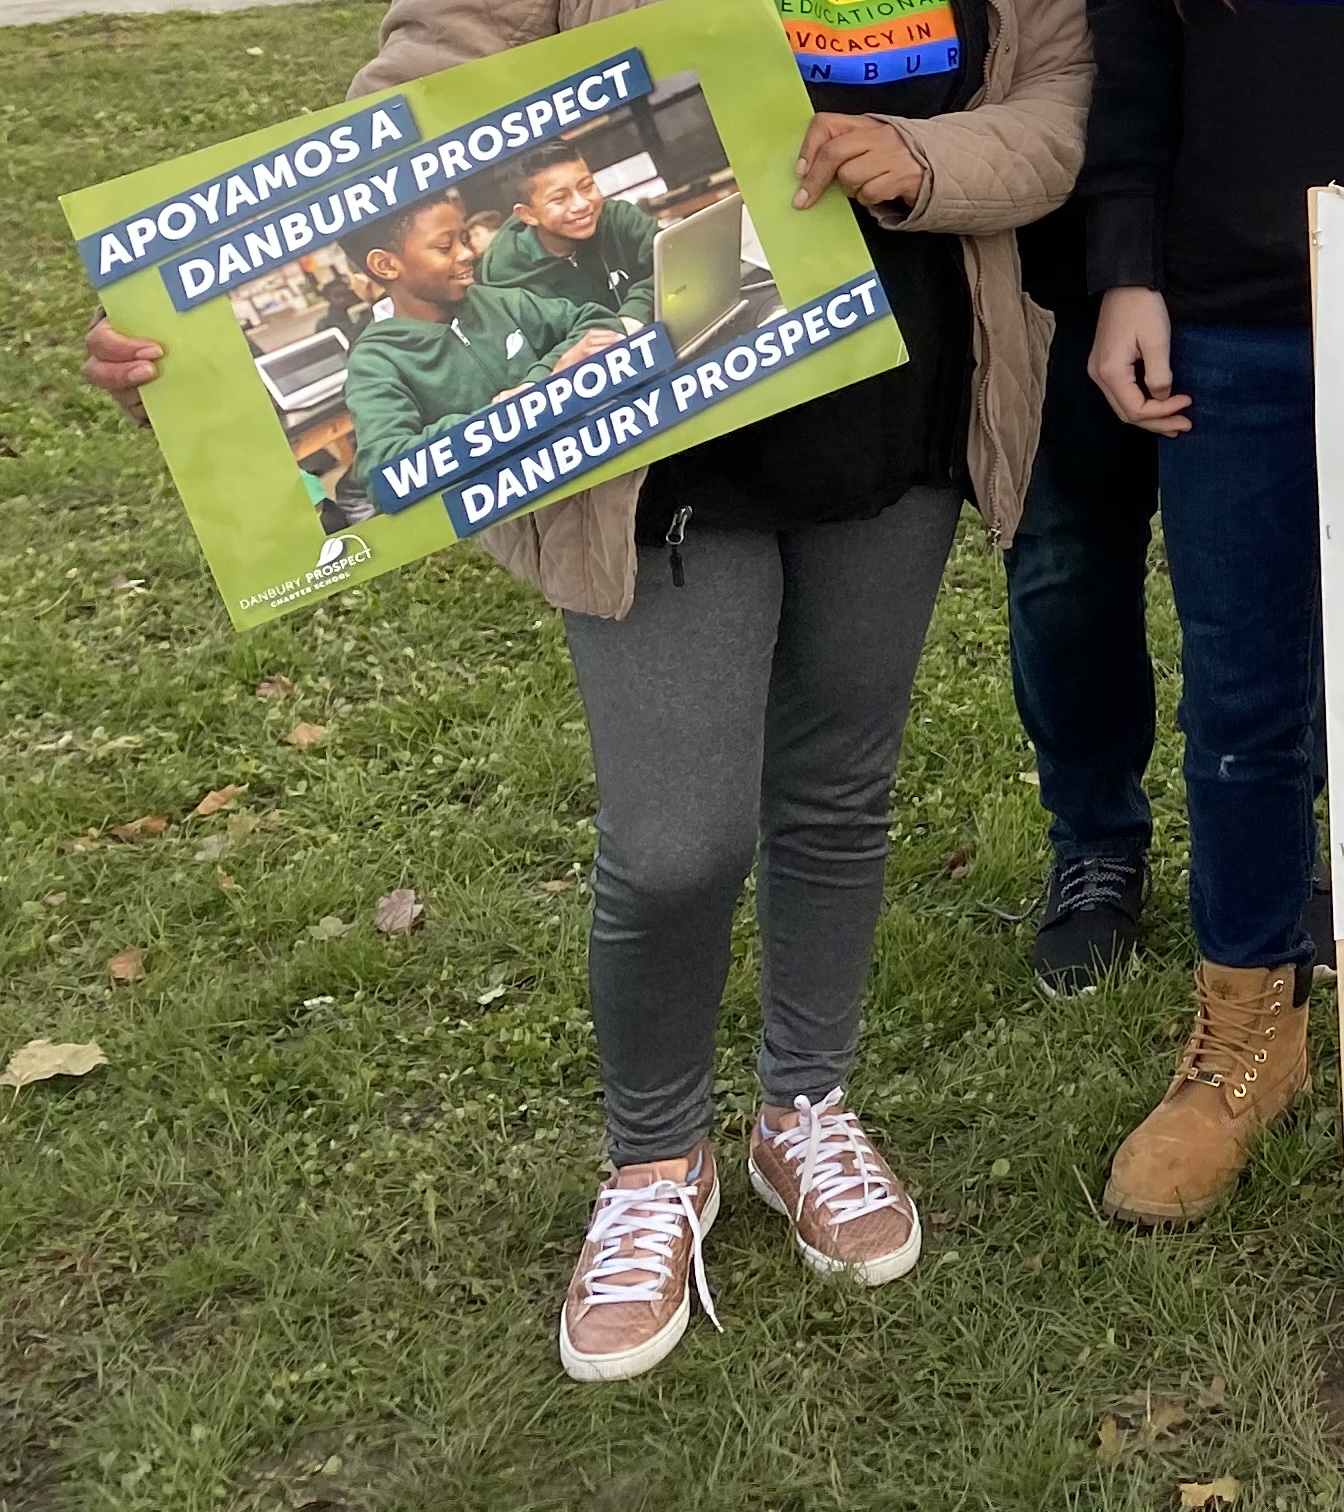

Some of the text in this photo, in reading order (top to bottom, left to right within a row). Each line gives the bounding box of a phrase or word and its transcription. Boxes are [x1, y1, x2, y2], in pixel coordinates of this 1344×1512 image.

[786, 23, 932, 53] VOCACY IN
[98, 109, 403, 274] APOYAMOS A
[176, 61, 634, 300] DANBURY PROSPECT
[381, 330, 658, 501] WE SUPPORT
[459, 279, 882, 525] DANBURY PROSPECT
[239, 548, 372, 610] DANBURY PROSPECT
[270, 571, 351, 608] CHARTER SCHOOL
